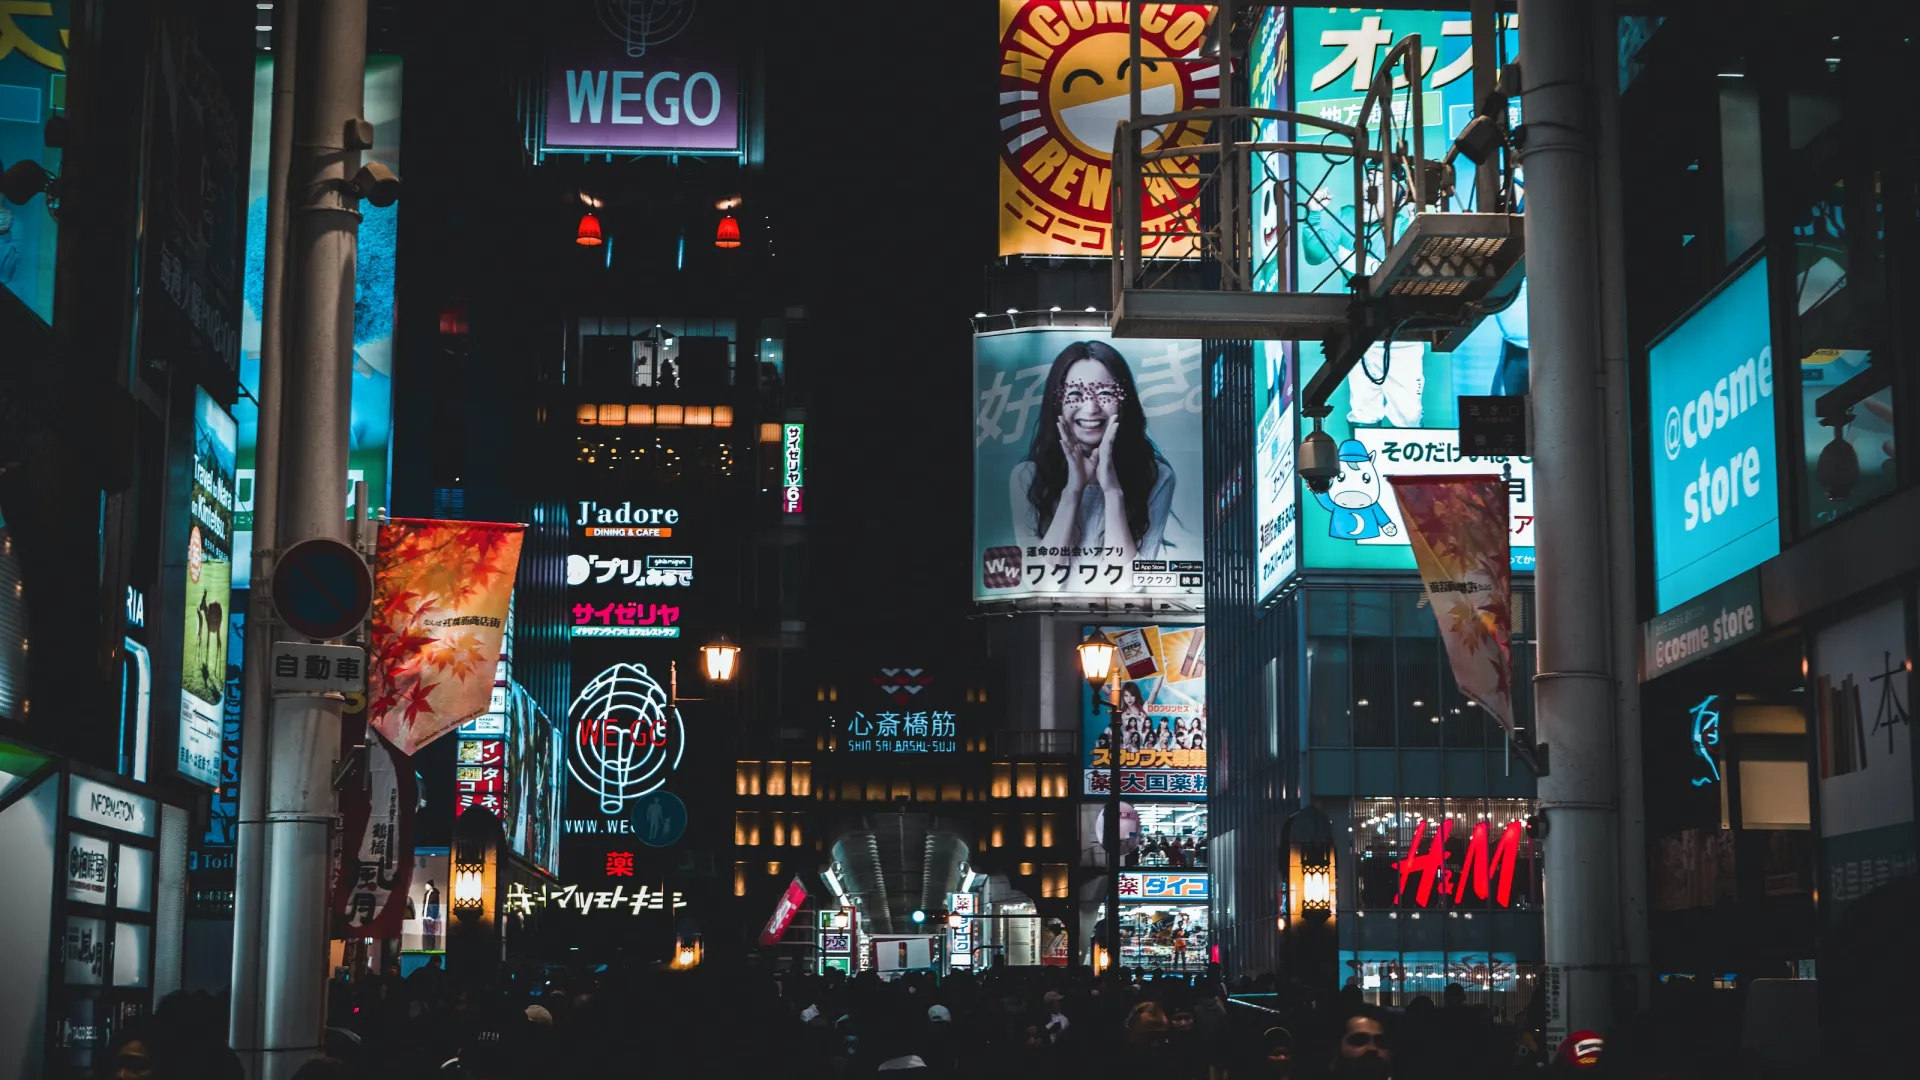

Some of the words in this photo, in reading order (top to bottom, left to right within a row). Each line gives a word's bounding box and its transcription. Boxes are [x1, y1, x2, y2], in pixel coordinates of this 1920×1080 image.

[1001, 0, 1206, 84] NICONCO
[566, 70, 721, 126] WEGO
[1022, 106, 1212, 211] RENAC
[1664, 345, 1773, 461] @cosme
[787, 428, 799, 483] サイゼリヤ
[1382, 442, 1533, 464] そのだけ
[194, 454, 213, 494] Travel
[217, 477, 232, 512] Nara
[1685, 446, 1760, 532] store
[787, 486, 799, 512] 6F
[198, 494, 226, 540] Kintetsu.
[576, 501, 679, 526] J'adore
[1509, 516, 1534, 534] ア
[594, 528, 626, 536] DINING
[627, 528, 635, 536] &
[636, 528, 660, 536] CAFE
[1026, 546, 1124, 557] 運命の出会いアプリ
[1026, 564, 1123, 586] ワクワク
[1137, 576, 1172, 584] ワクワク
[1181, 576, 1201, 585] 検索
[572, 602, 680, 626] サイゼリヤ
[1656, 624, 1709, 668] @cosme
[1713, 605, 1754, 644] store
[275, 655, 361, 682] 自動車
[580, 718, 666, 747] WEGO
[847, 710, 956, 737] 心斎橋筋
[848, 740, 872, 752] SHIN
[565, 820, 636, 834] WWW.WE
[606, 852, 634, 876] 薬
[1391, 819, 1522, 908] H&M
[1118, 875, 1138, 895] 薬
